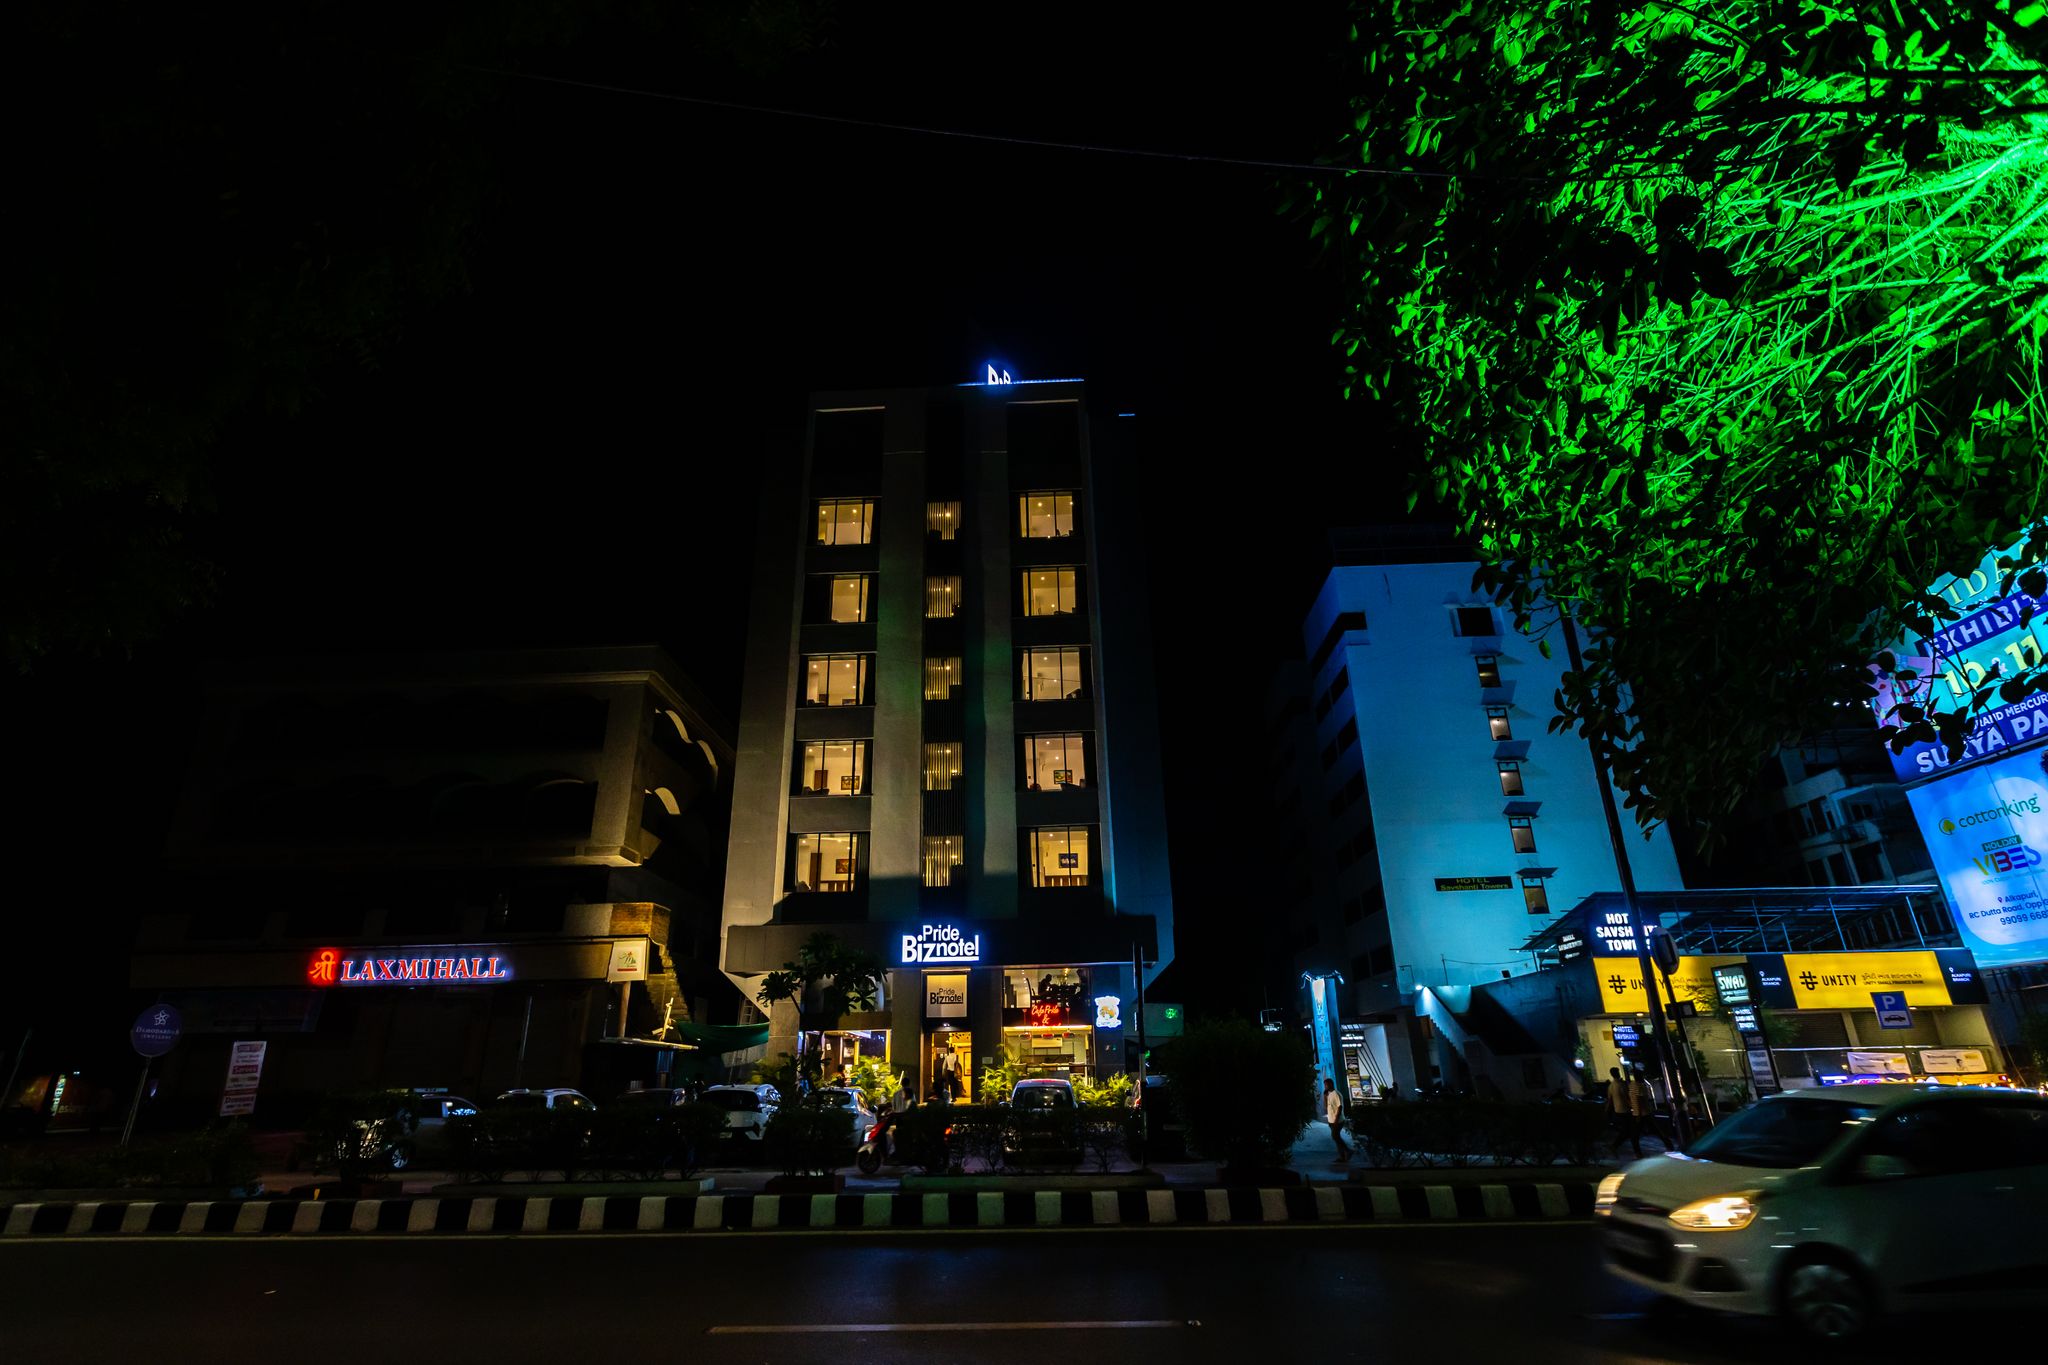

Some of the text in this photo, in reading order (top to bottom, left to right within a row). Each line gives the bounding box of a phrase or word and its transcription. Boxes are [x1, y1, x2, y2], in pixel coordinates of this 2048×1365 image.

[1944, 661, 1987, 697] 10
[2004, 635, 2043, 671] 11
[1958, 796, 2041, 828] cottonking
[1984, 836, 2018, 851] HOLIDAY
[1972, 845, 2042, 876] VIBES
[1969, 911, 1980, 919] RC
[1981, 908, 2002, 917] Dutta
[1999, 913, 2028, 926] 99099
[922, 924, 960, 942] Pride
[901, 934, 980, 963] Biznotel
[309, 951, 505, 981] श्री LAXMI HALL
[1717, 974, 1747, 990] SWAD
[1821, 975, 1857, 987] UNITY
[929, 991, 964, 1005] Biznotel
[938, 988, 956, 996] Pride
[1881, 995, 1896, 1010] P
